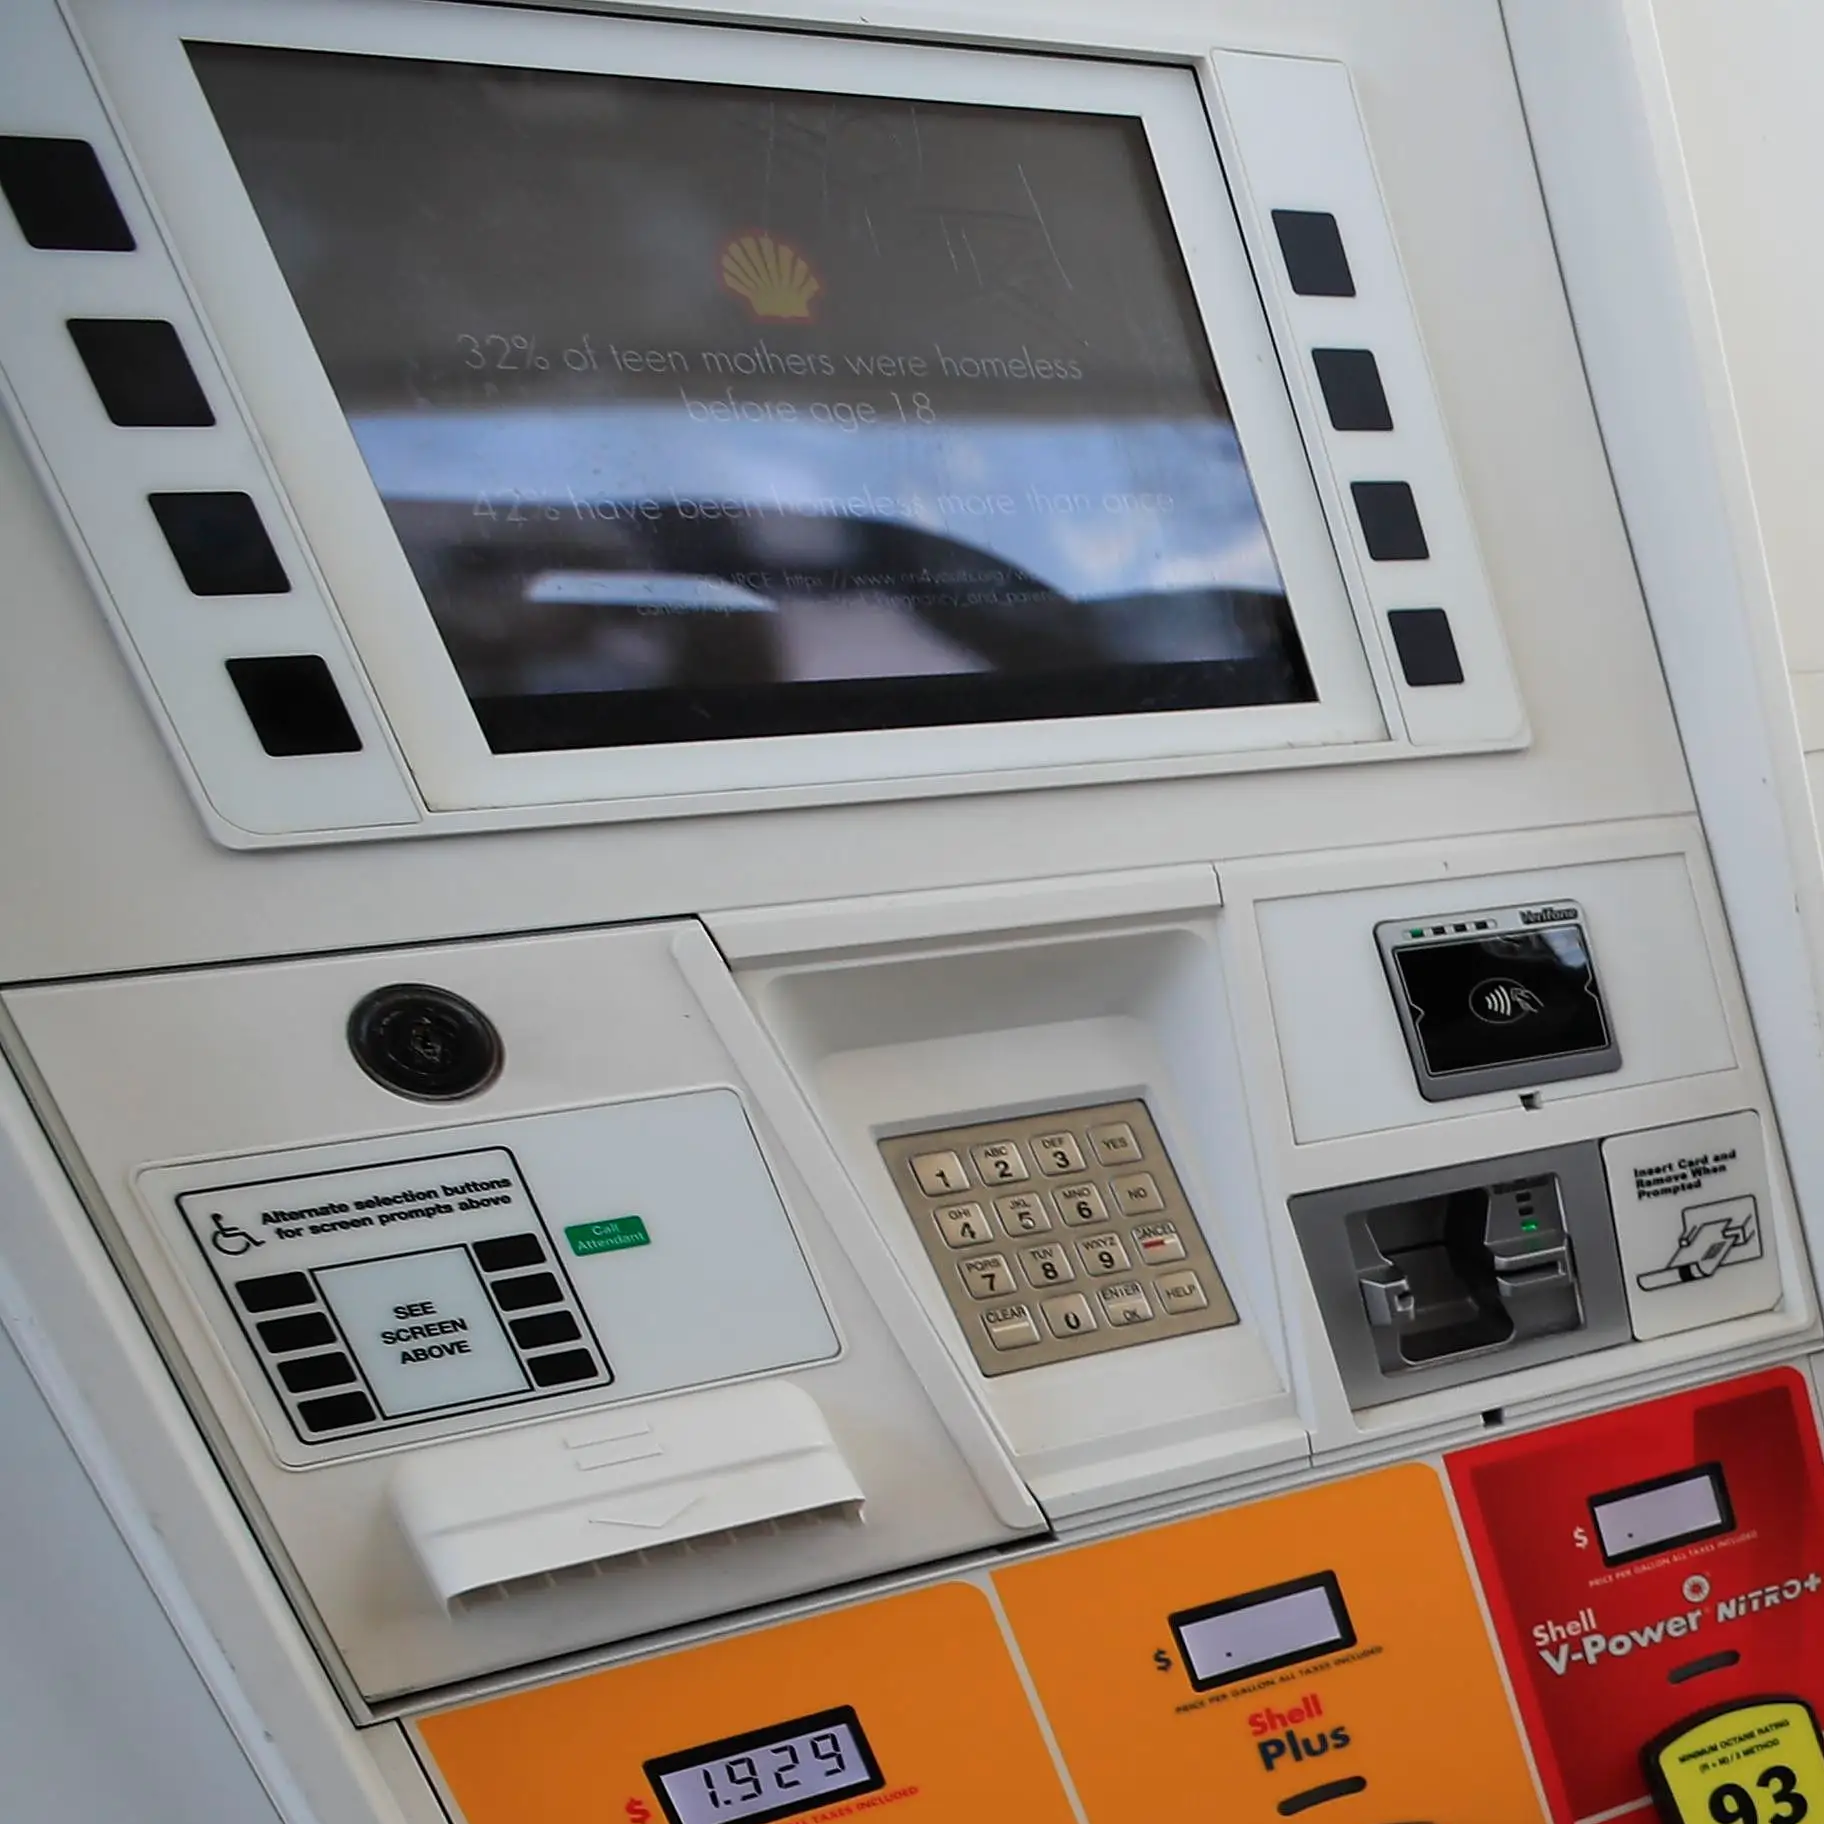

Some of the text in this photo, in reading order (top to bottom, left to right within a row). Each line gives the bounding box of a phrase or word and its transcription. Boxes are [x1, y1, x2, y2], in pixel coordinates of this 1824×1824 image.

[457, 333, 1083, 381] 32% of teen mothers were homeless
[679, 384, 936, 433] before age 18
[567, 484, 663, 521] have
[669, 486, 765, 520] been
[770, 482, 923, 518] homeless
[937, 493, 1017, 515] more
[1026, 484, 1091, 514] than
[984, 1146, 1009, 1158] ABC
[1041, 1136, 1066, 1149] DEF
[1102, 1136, 1128, 1150] YES
[994, 1160, 1013, 1178] 2
[1053, 1150, 1069, 1169] 3
[1634, 1149, 1736, 1178] Insert Card and
[935, 1170, 950, 1188] 1
[1636, 1164, 1727, 1189] Remove When
[1062, 1187, 1091, 1200] MNO
[1127, 1187, 1148, 1200] NO
[1638, 1179, 1702, 1200] Prompted
[261, 1175, 513, 1227] Alternate selection buttons
[1008, 1198, 1032, 1210] JKL
[1078, 1200, 1093, 1219] 6
[274, 1193, 513, 1241] for screen prompts above
[1017, 1211, 1035, 1230] 5
[592, 1221, 622, 1237] Call
[960, 1222, 976, 1240] 4
[1136, 1223, 1176, 1240] CANCEL
[576, 1230, 646, 1253] Attendant
[1081, 1236, 1118, 1251] WXYZ
[1030, 1248, 1054, 1261] TUV
[1099, 1250, 1114, 1269] 9
[966, 1258, 1001, 1273] PQRS
[1042, 1261, 1058, 1281] 8
[980, 1273, 997, 1292] 7
[1101, 1284, 1141, 1300] ENTER
[1166, 1285, 1196, 1299] HELP
[393, 1301, 438, 1320] SEE
[985, 1306, 1027, 1323] CLEAR
[1122, 1310, 1142, 1322] OK
[1064, 1310, 1081, 1331] 0
[381, 1318, 469, 1346] SCREEN
[400, 1339, 472, 1366] ABOVE
[1573, 1526, 1588, 1549] $
[1588, 1530, 1758, 1588] PRICE PER GALLON ALL TAXES INCLUDED
[1532, 1608, 1597, 1647] Shell
[1539, 1609, 1702, 1676] V-Power
[1153, 1648, 1173, 1673] $
[1175, 1645, 1384, 1714] PRICE PER GALLON ALL TAXES INCLUDED
[1248, 1693, 1323, 1737] Shell
[1258, 1726, 1351, 1772] Plus
[1678, 1718, 1790, 1764] MINIMUM OCTANE RATING
[702, 1732, 846, 1809] 1.929
[855, 1784, 920, 1811] INCLUDED
